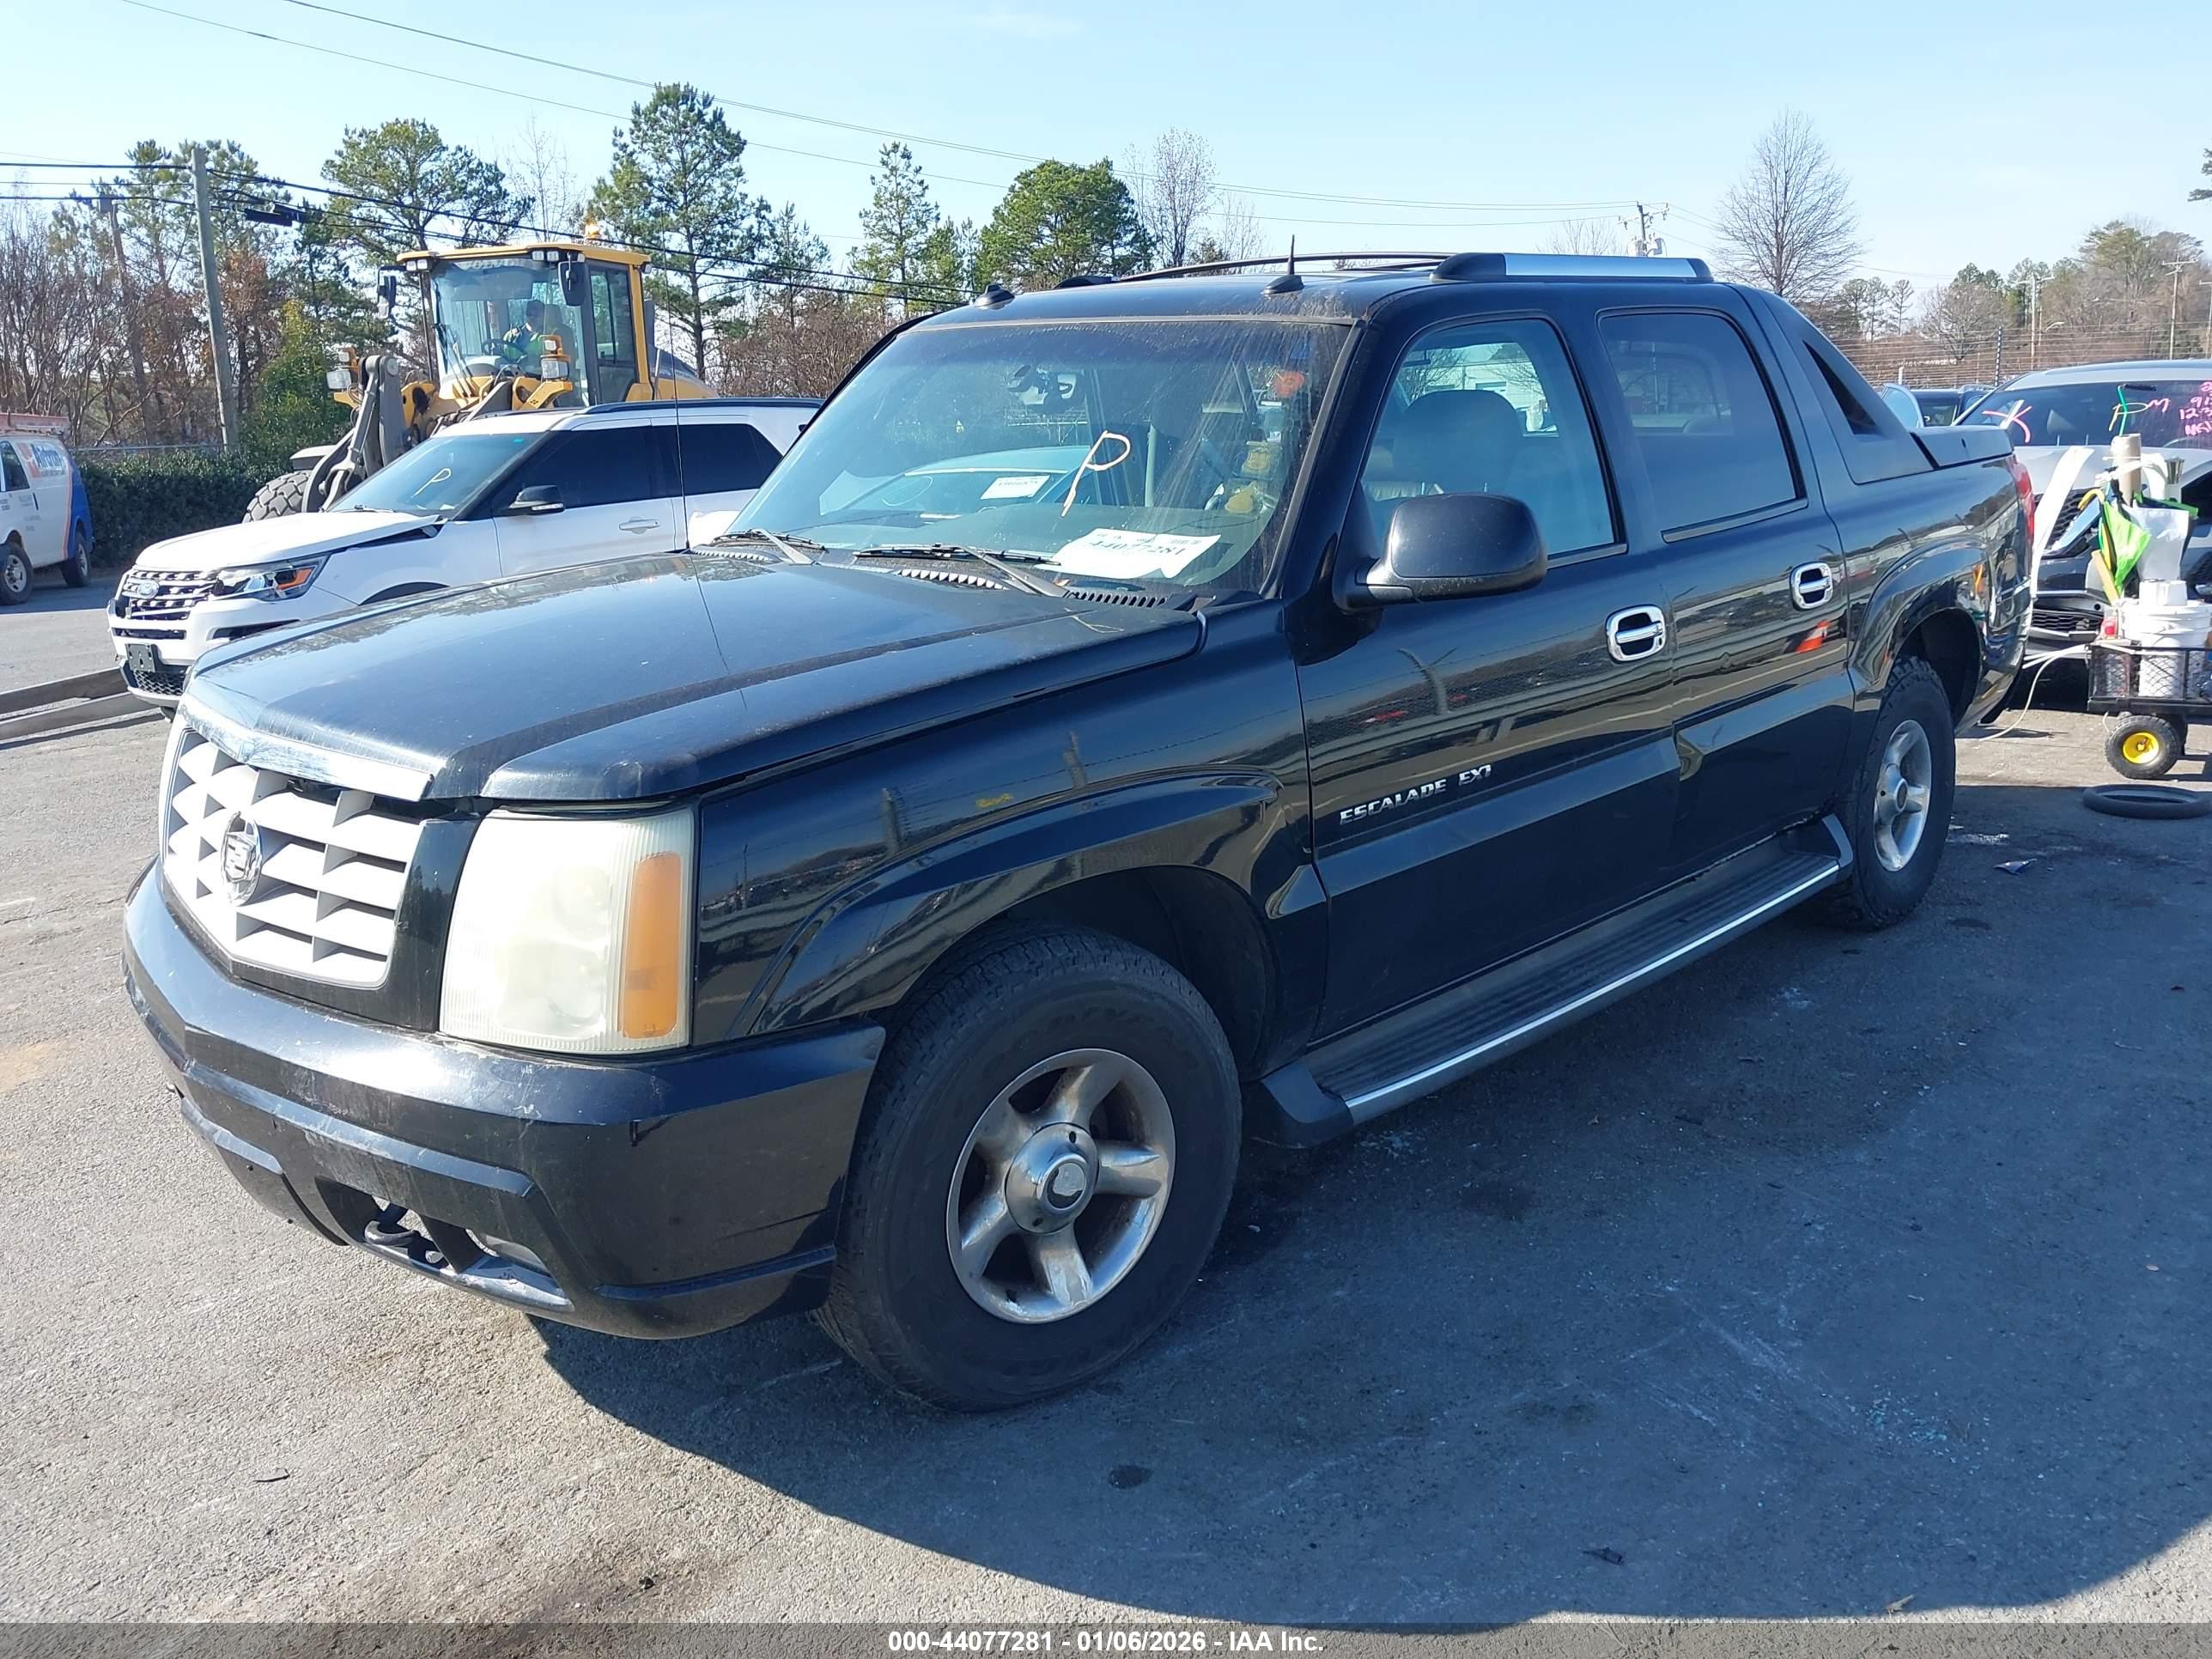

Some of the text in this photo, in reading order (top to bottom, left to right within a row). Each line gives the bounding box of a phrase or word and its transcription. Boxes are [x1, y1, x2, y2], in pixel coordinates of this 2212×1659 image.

[410, 467, 452, 499] P
[1060, 429, 1132, 518] P
[1340, 779, 1447, 825] ESCALADE
